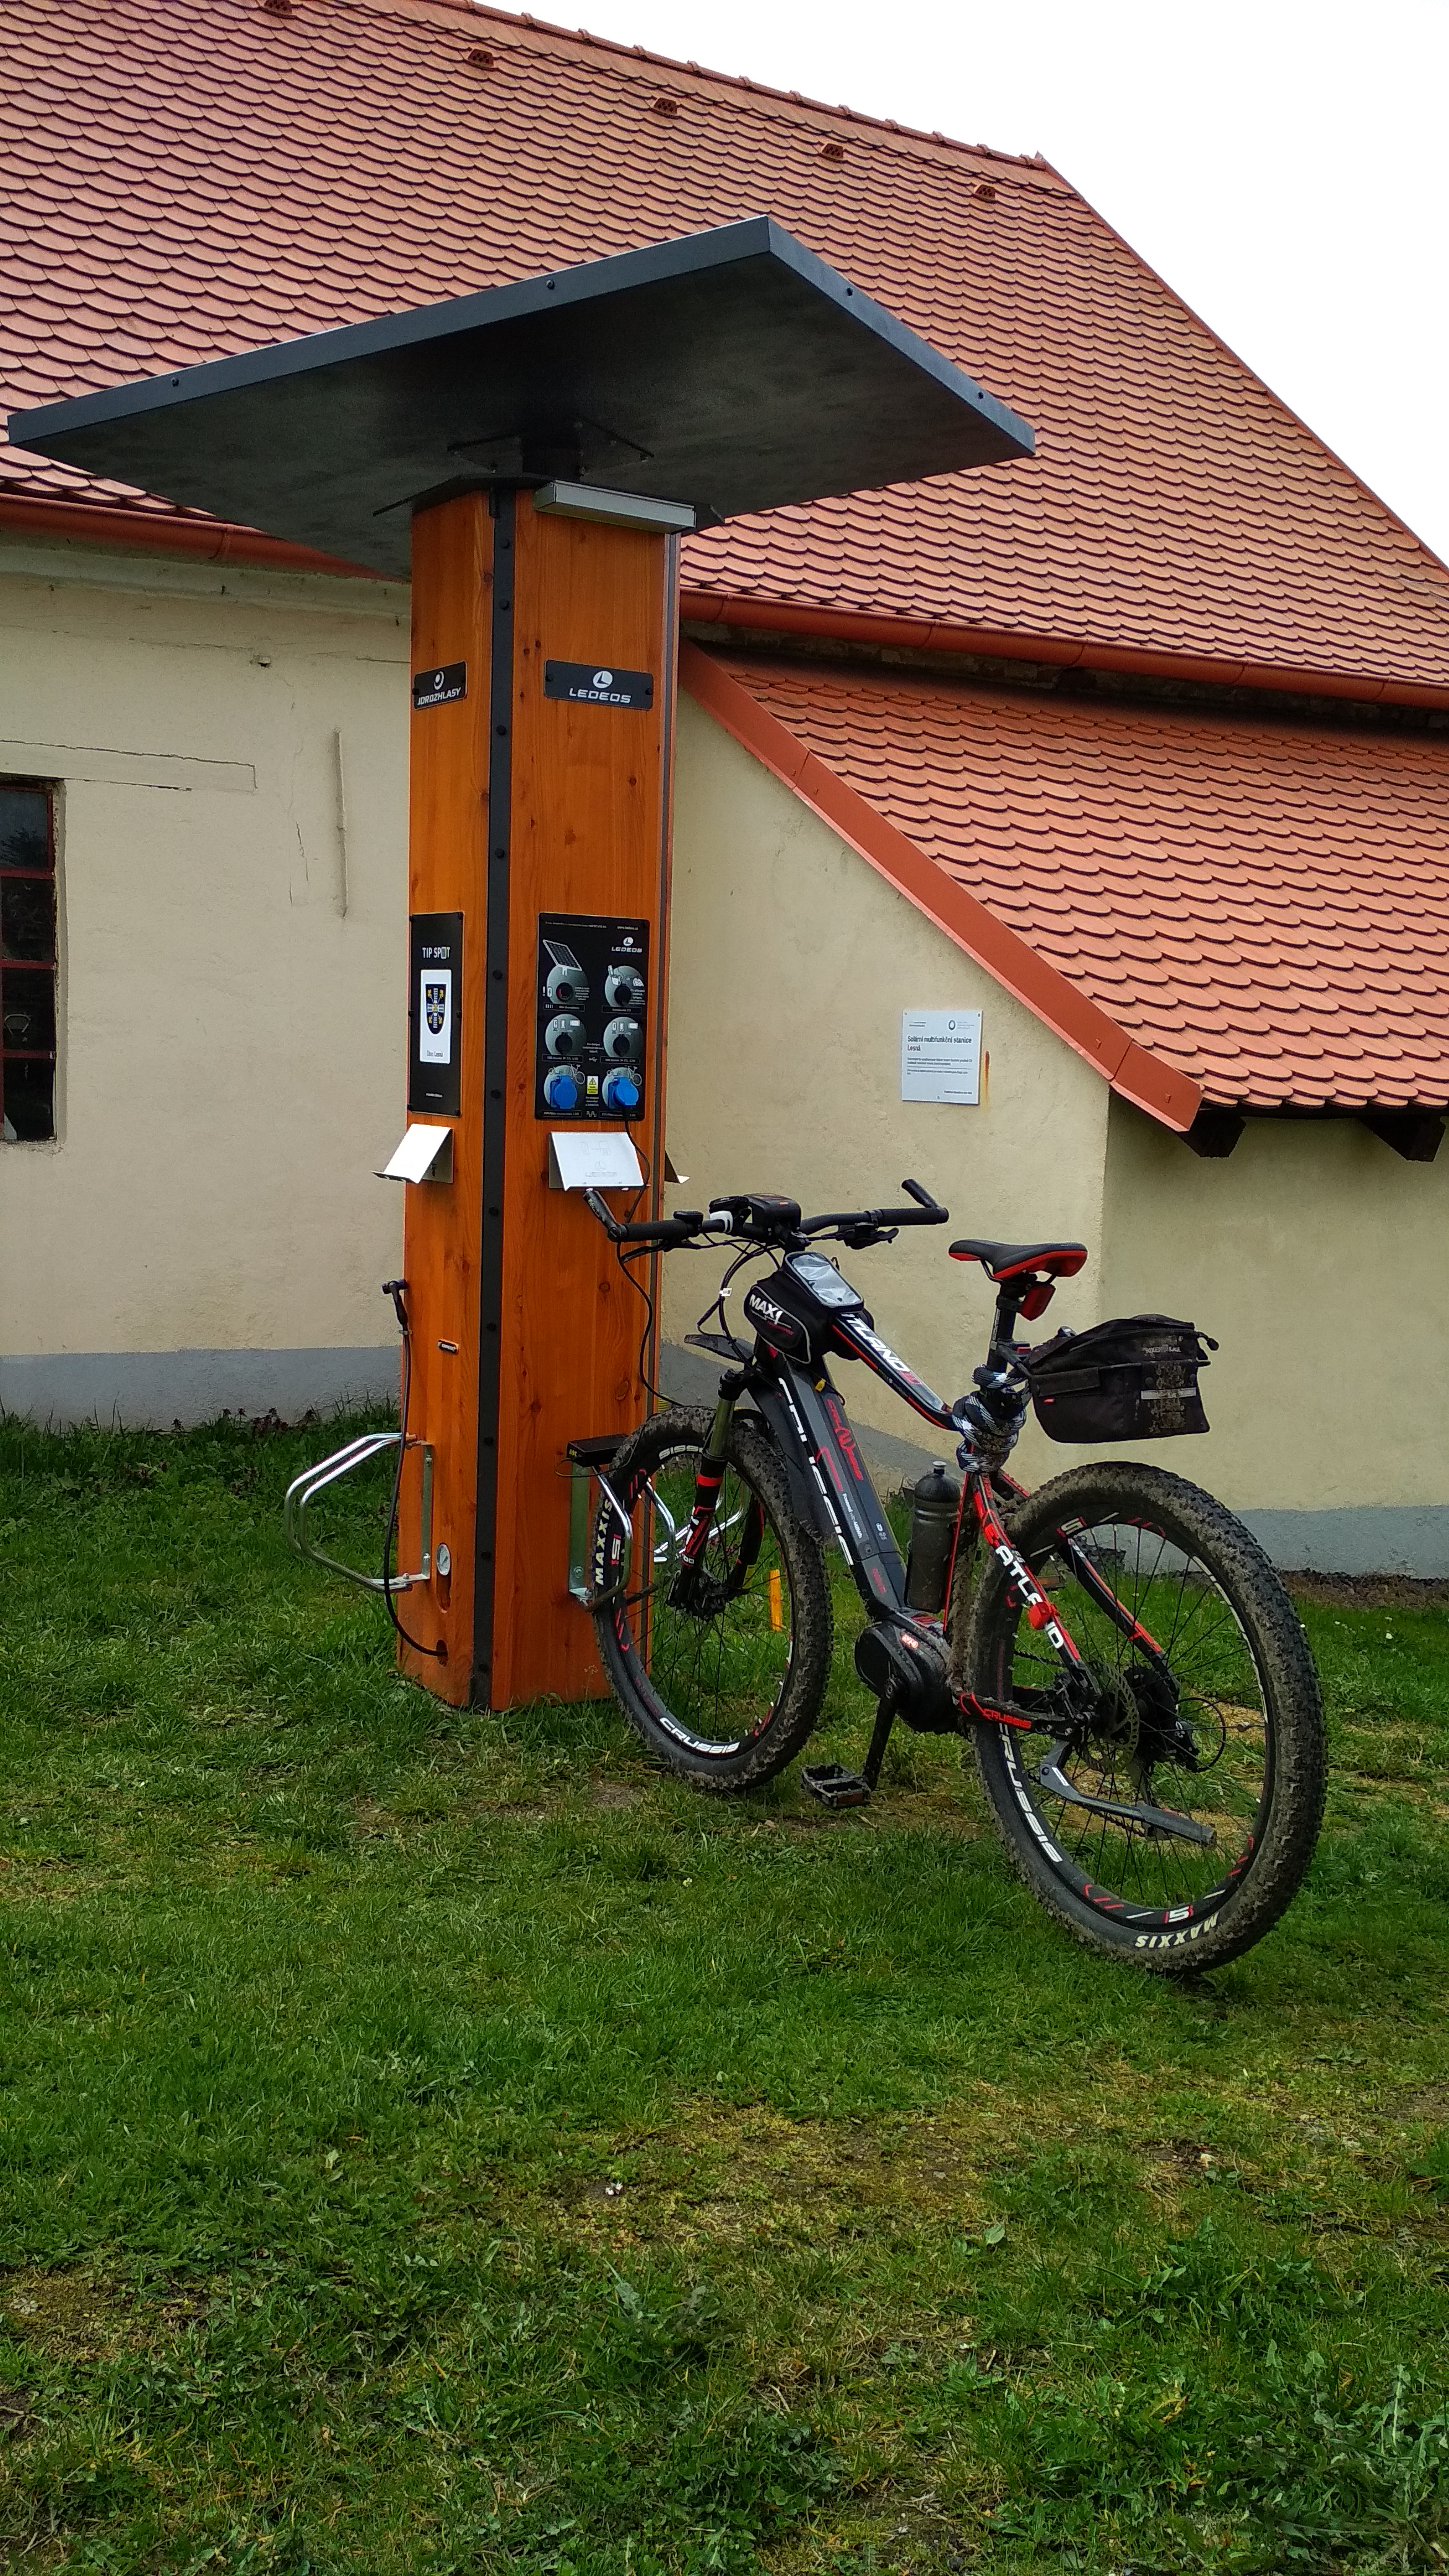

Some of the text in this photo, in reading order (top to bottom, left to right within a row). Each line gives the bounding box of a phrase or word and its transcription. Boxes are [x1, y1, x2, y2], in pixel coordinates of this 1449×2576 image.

[417, 687, 461, 705] JDROZHLASY
[568, 687, 632, 703] LEDEOS
[422, 946, 451, 959] TIP SPOT
[749, 1294, 783, 1325] MAX1
[595, 1499, 612, 1586] MAXXIS
[659, 1717, 741, 1754] CRUSSIS
[1134, 1912, 1220, 1949] MAXXIS
